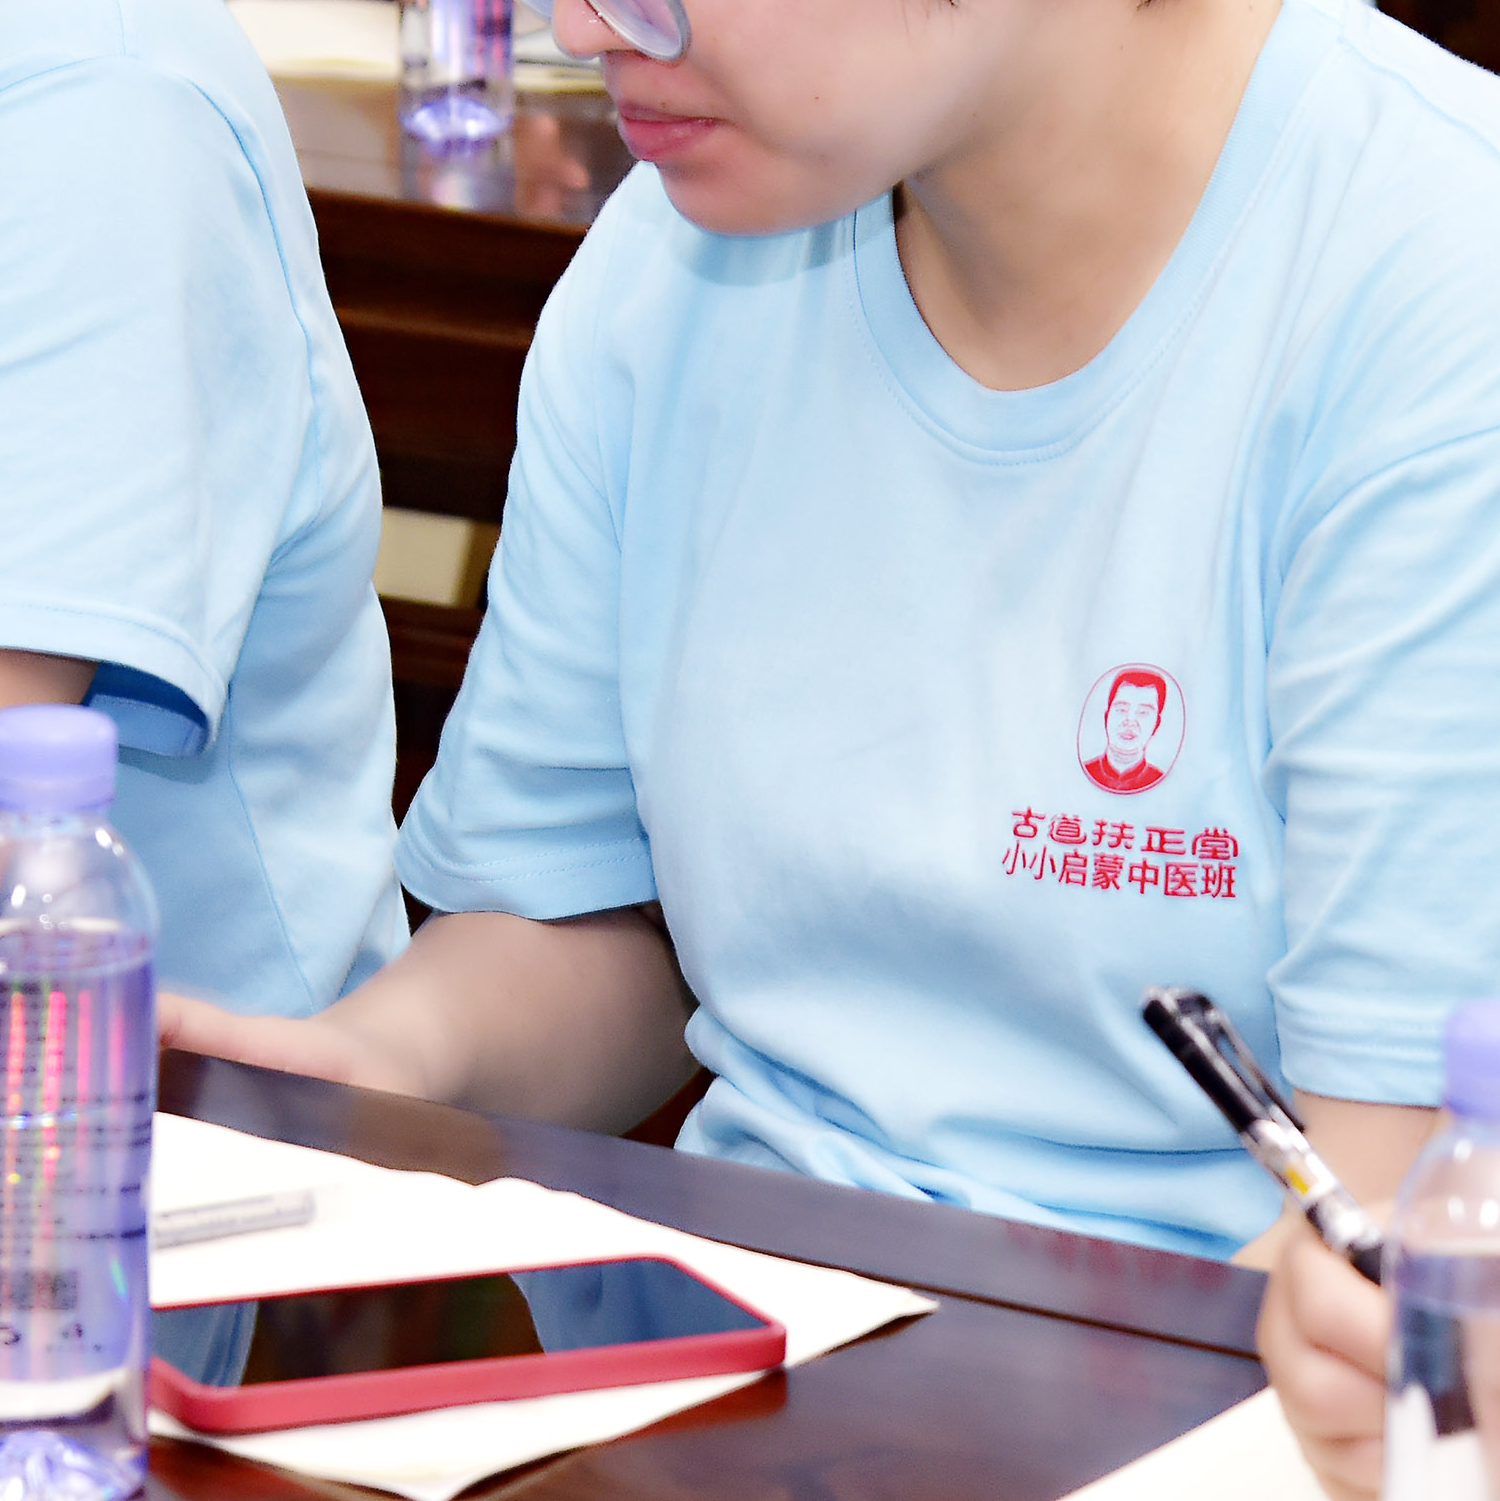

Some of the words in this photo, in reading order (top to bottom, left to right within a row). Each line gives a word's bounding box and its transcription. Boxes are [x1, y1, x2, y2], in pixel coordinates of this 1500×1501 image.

[1011, 806, 1239, 861] 古道扶正堂
[1002, 840, 1238, 899] 小小启蒙中医班
